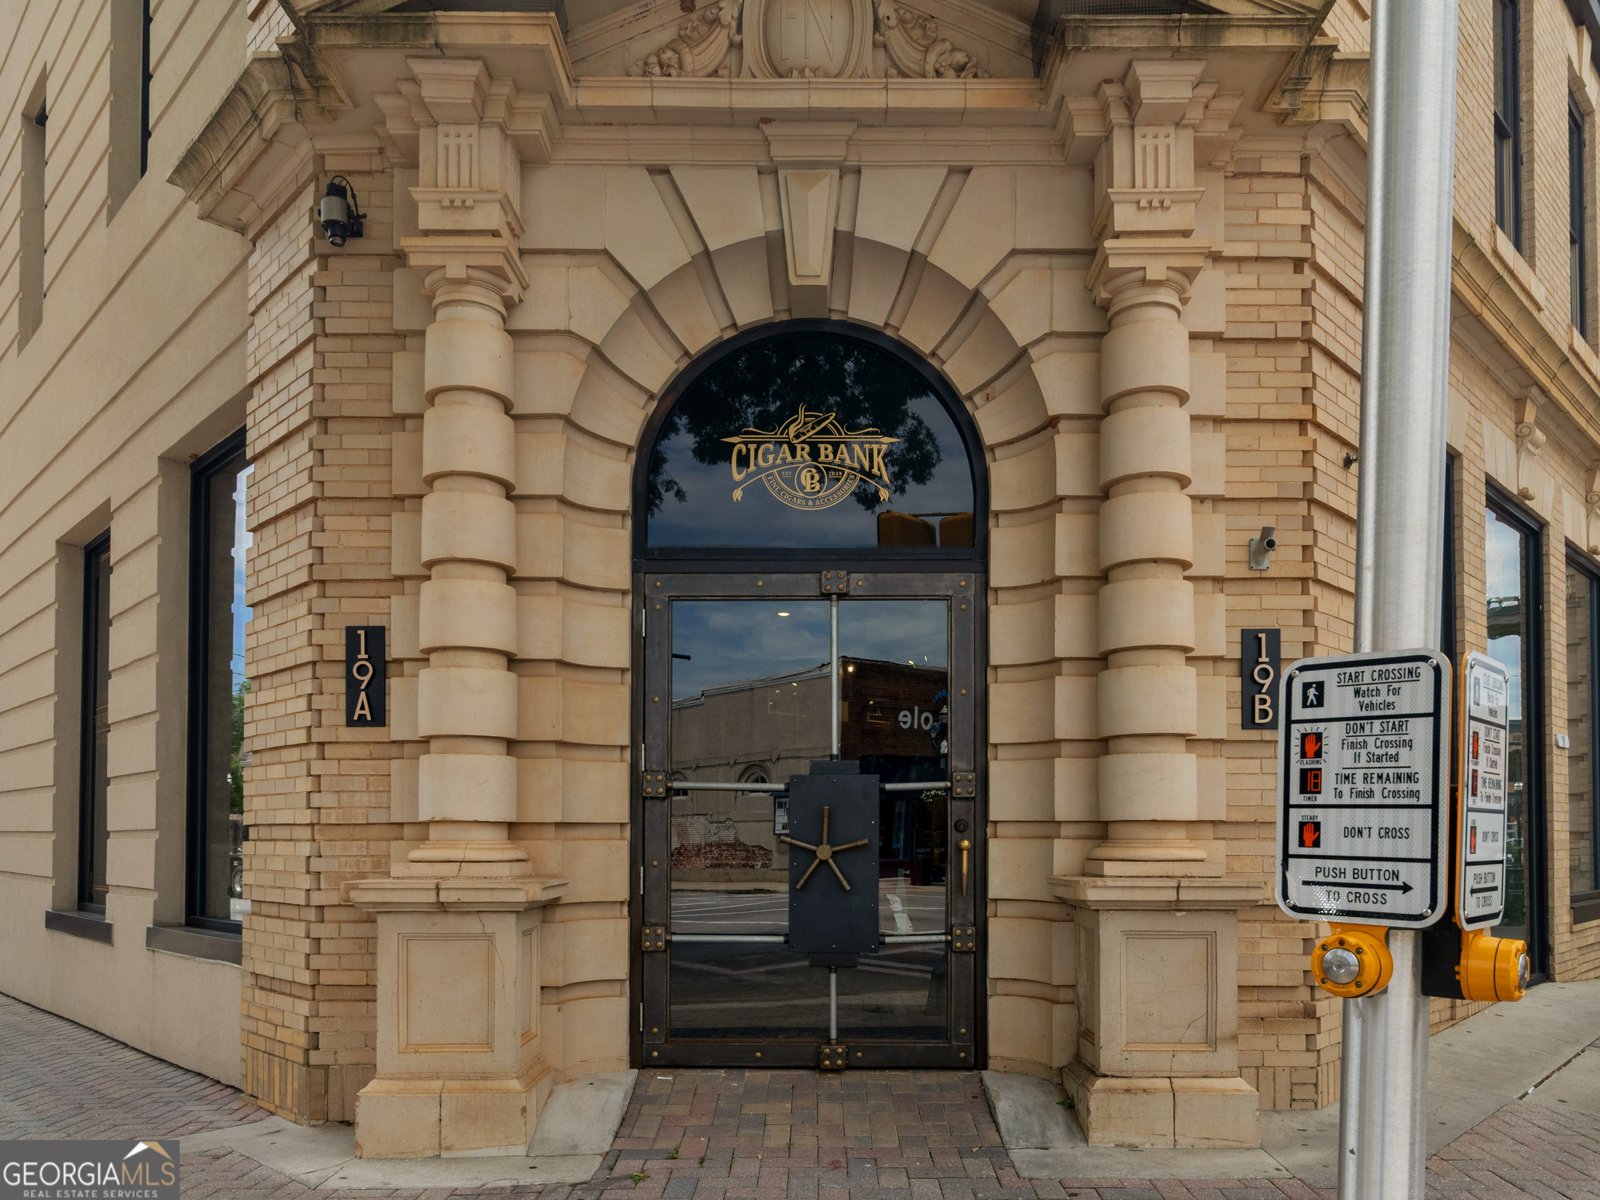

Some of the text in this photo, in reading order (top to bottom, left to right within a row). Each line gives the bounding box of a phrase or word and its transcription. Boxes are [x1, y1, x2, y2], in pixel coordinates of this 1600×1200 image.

[731, 443, 891, 484] CIGAR BANK
[767, 475, 781, 491] FINE
[780, 490, 806, 506] CIGARS
[815, 474, 856, 506] ACCESSORIES
[1336, 666, 1421, 685] START CROSSING
[1353, 685, 1401, 699] Watch For
[1358, 700, 1396, 712] Vehicles
[1345, 720, 1410, 735] DON'T START
[1341, 736, 1413, 752] Finish Crossing
[1300, 758, 1322, 766] FLASHING
[1353, 751, 1399, 764] If Started
[1334, 771, 1419, 785] TIME REMAINING
[1333, 787, 1420, 802] To Finish Crossing
[1343, 826, 1410, 840] DON'T CROSS
[1315, 866, 1400, 882] PUSH BUTTON
[1326, 890, 1387, 905] TO CROSS
